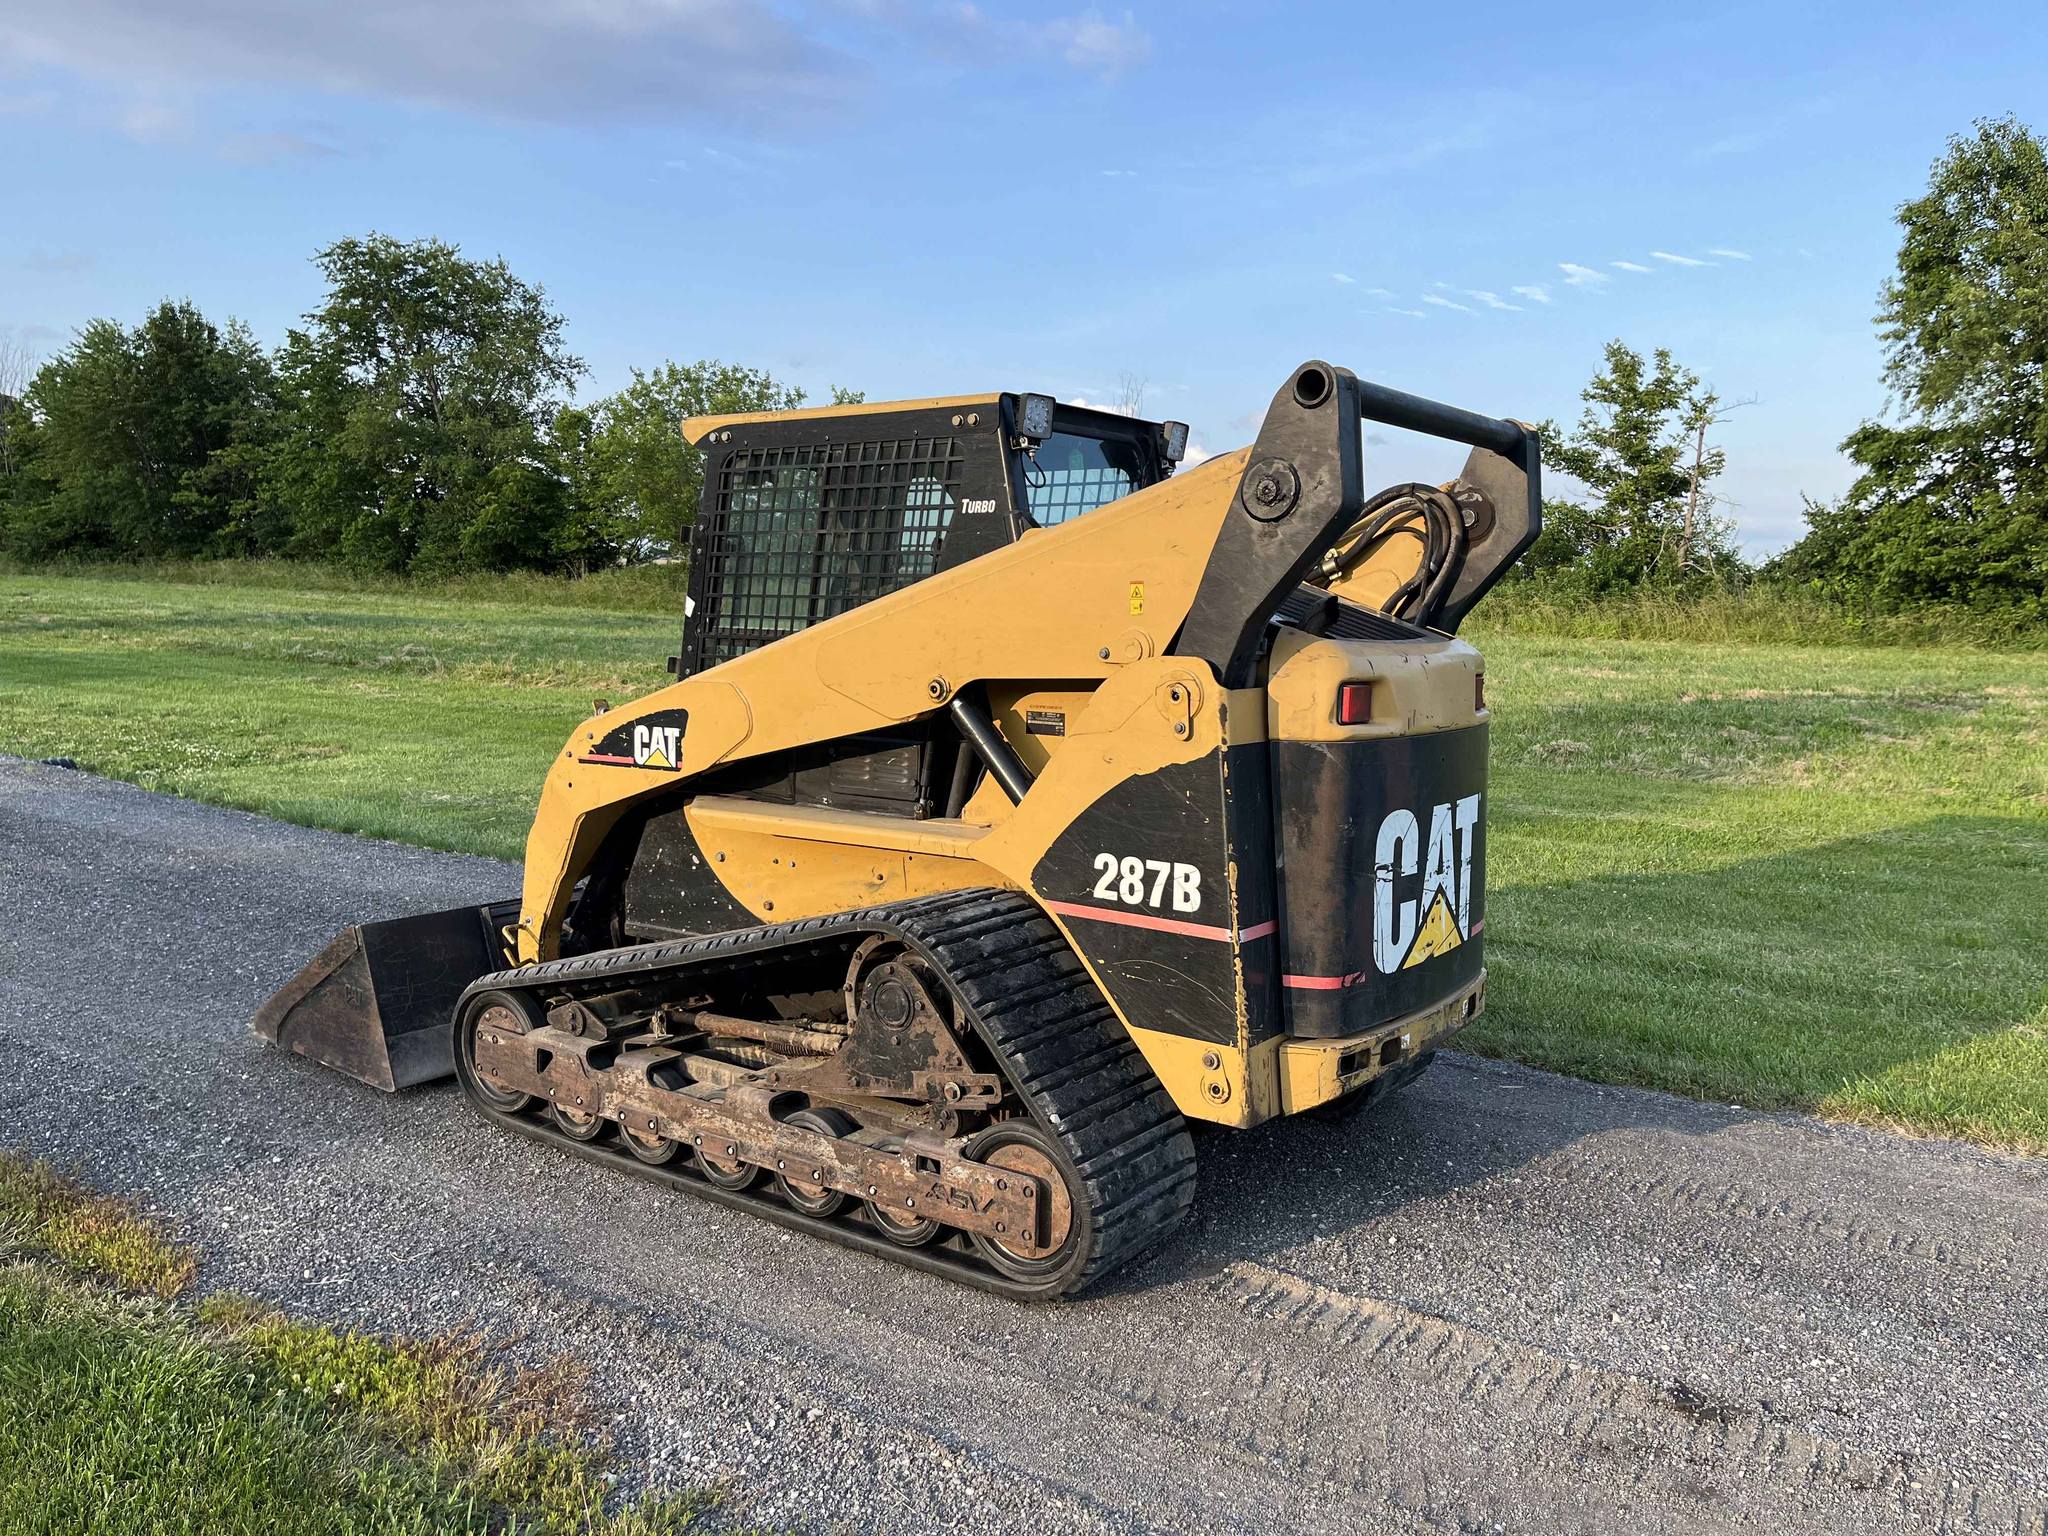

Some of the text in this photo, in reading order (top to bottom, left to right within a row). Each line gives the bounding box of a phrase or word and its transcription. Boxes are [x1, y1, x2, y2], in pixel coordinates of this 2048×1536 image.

[633, 724, 680, 768] CAT
[1093, 852, 1202, 913] 287B
[1373, 793, 1481, 974] CAT
